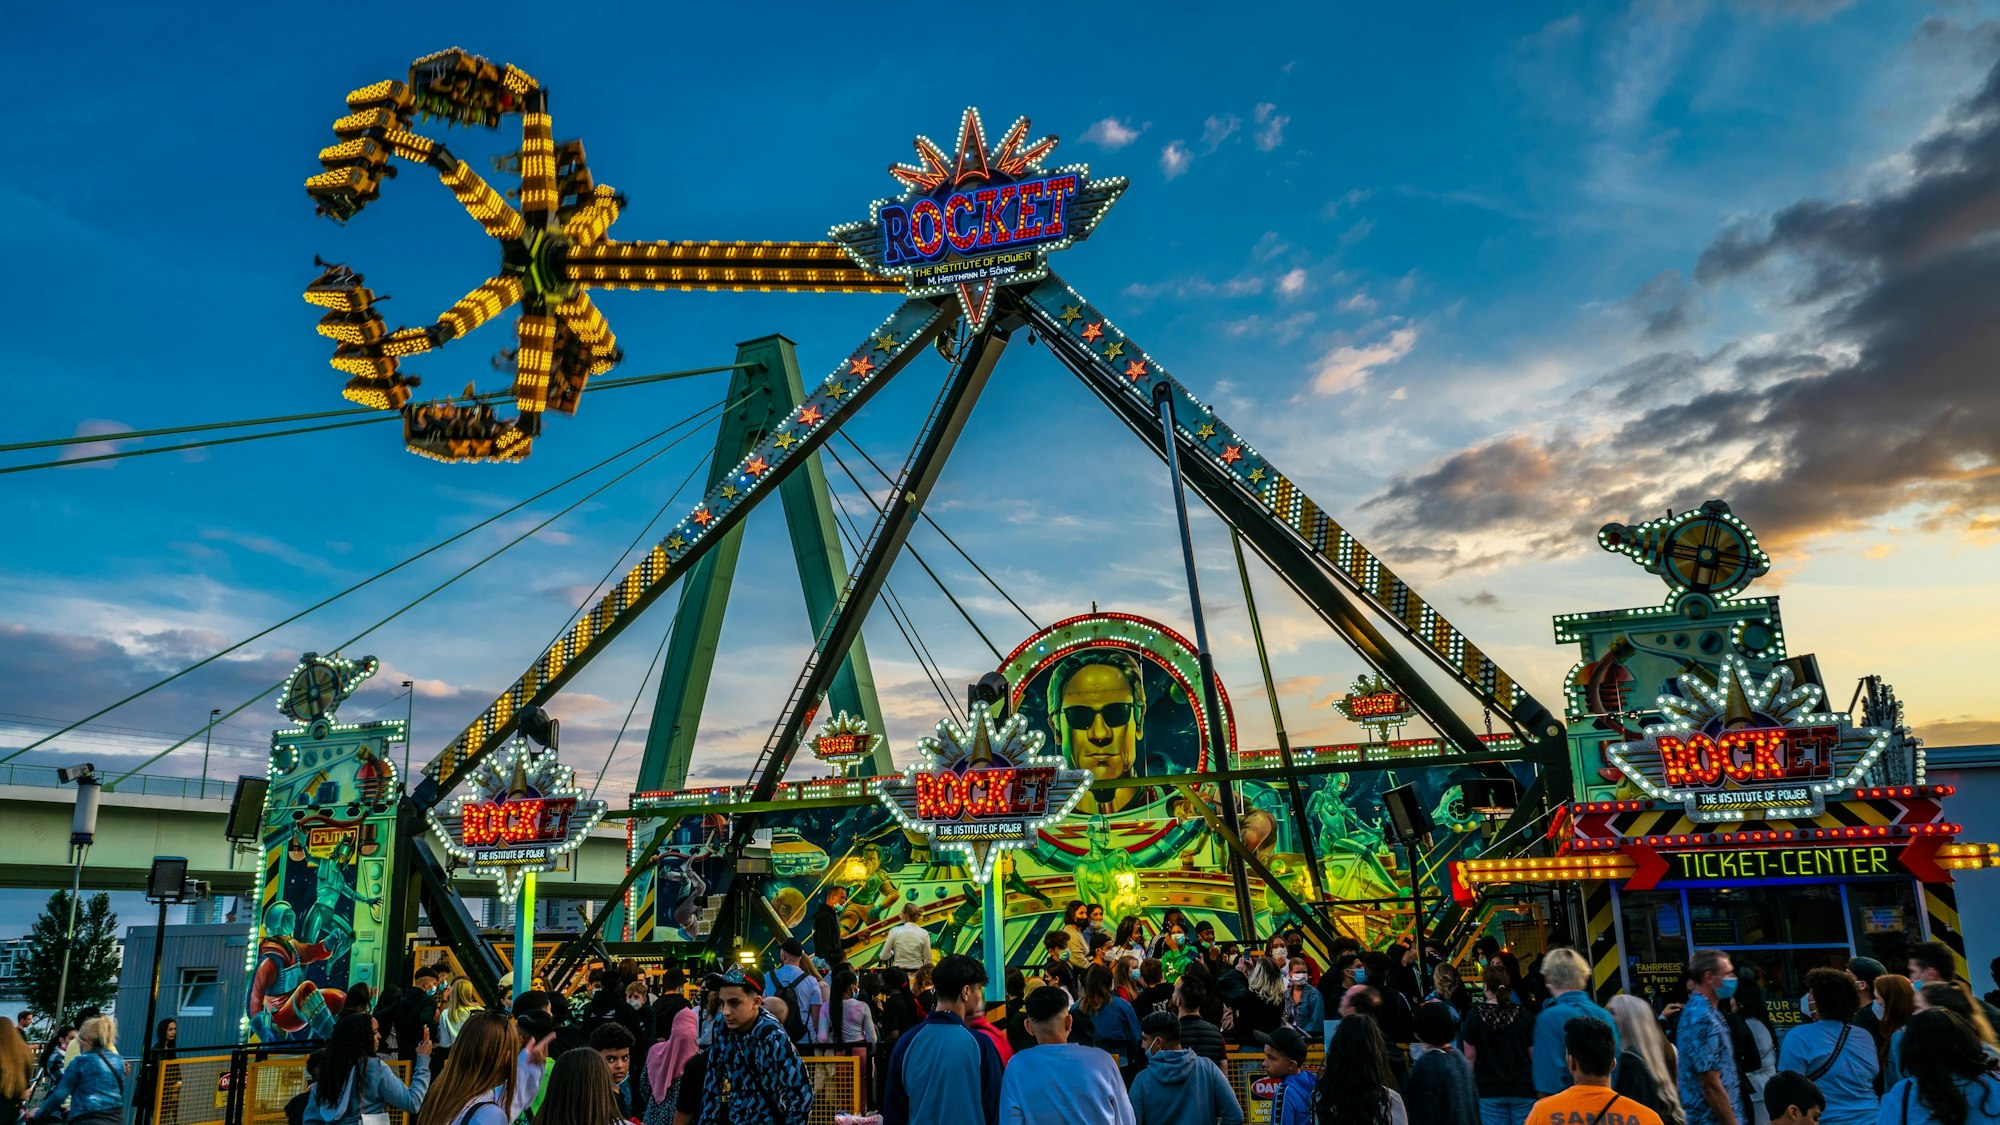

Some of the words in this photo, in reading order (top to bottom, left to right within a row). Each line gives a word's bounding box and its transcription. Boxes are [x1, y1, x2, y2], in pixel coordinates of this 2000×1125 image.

[880, 173, 1079, 265] ROCKET
[914, 266, 933, 278] THE
[934, 259, 981, 275] INSTITUTE
[982, 256, 995, 268] OF
[997, 251, 1031, 265] POWER
[927, 277, 937, 286] M.
[939, 272, 978, 284] HARTMANN
[979, 268, 988, 278] &
[989, 265, 1016, 276] SÖHNE
[819, 735, 870, 755] ROCKET
[1656, 726, 1839, 786] ROCKET
[916, 767, 1057, 818] ROCKET
[1701, 793, 1716, 805] THE
[1718, 791, 1763, 804] INSTITUTE
[1764, 790, 1776, 802] OF
[1778, 788, 1807, 801] POWER
[462, 797, 577, 845] ROCKET
[939, 825, 952, 835] THE
[953, 823, 988, 835] INSTITUTE
[988, 823, 998, 834] OF
[999, 822, 1022, 833] POWER
[478, 851, 489, 860] THE
[489, 850, 517, 860] INSTITUTE
[517, 849, 525, 858] OF
[525, 848, 545, 858] POWER
[1677, 847, 1889, 878] TICKET-CENTER
[1636, 962, 1681, 971] FAHRPREIS
[1651, 974, 1678, 983] Person
[1766, 1000, 1790, 1011] ZUR
[1768, 1011, 1802, 1023] ASSE
[1255, 1082, 1282, 1094] DAN
